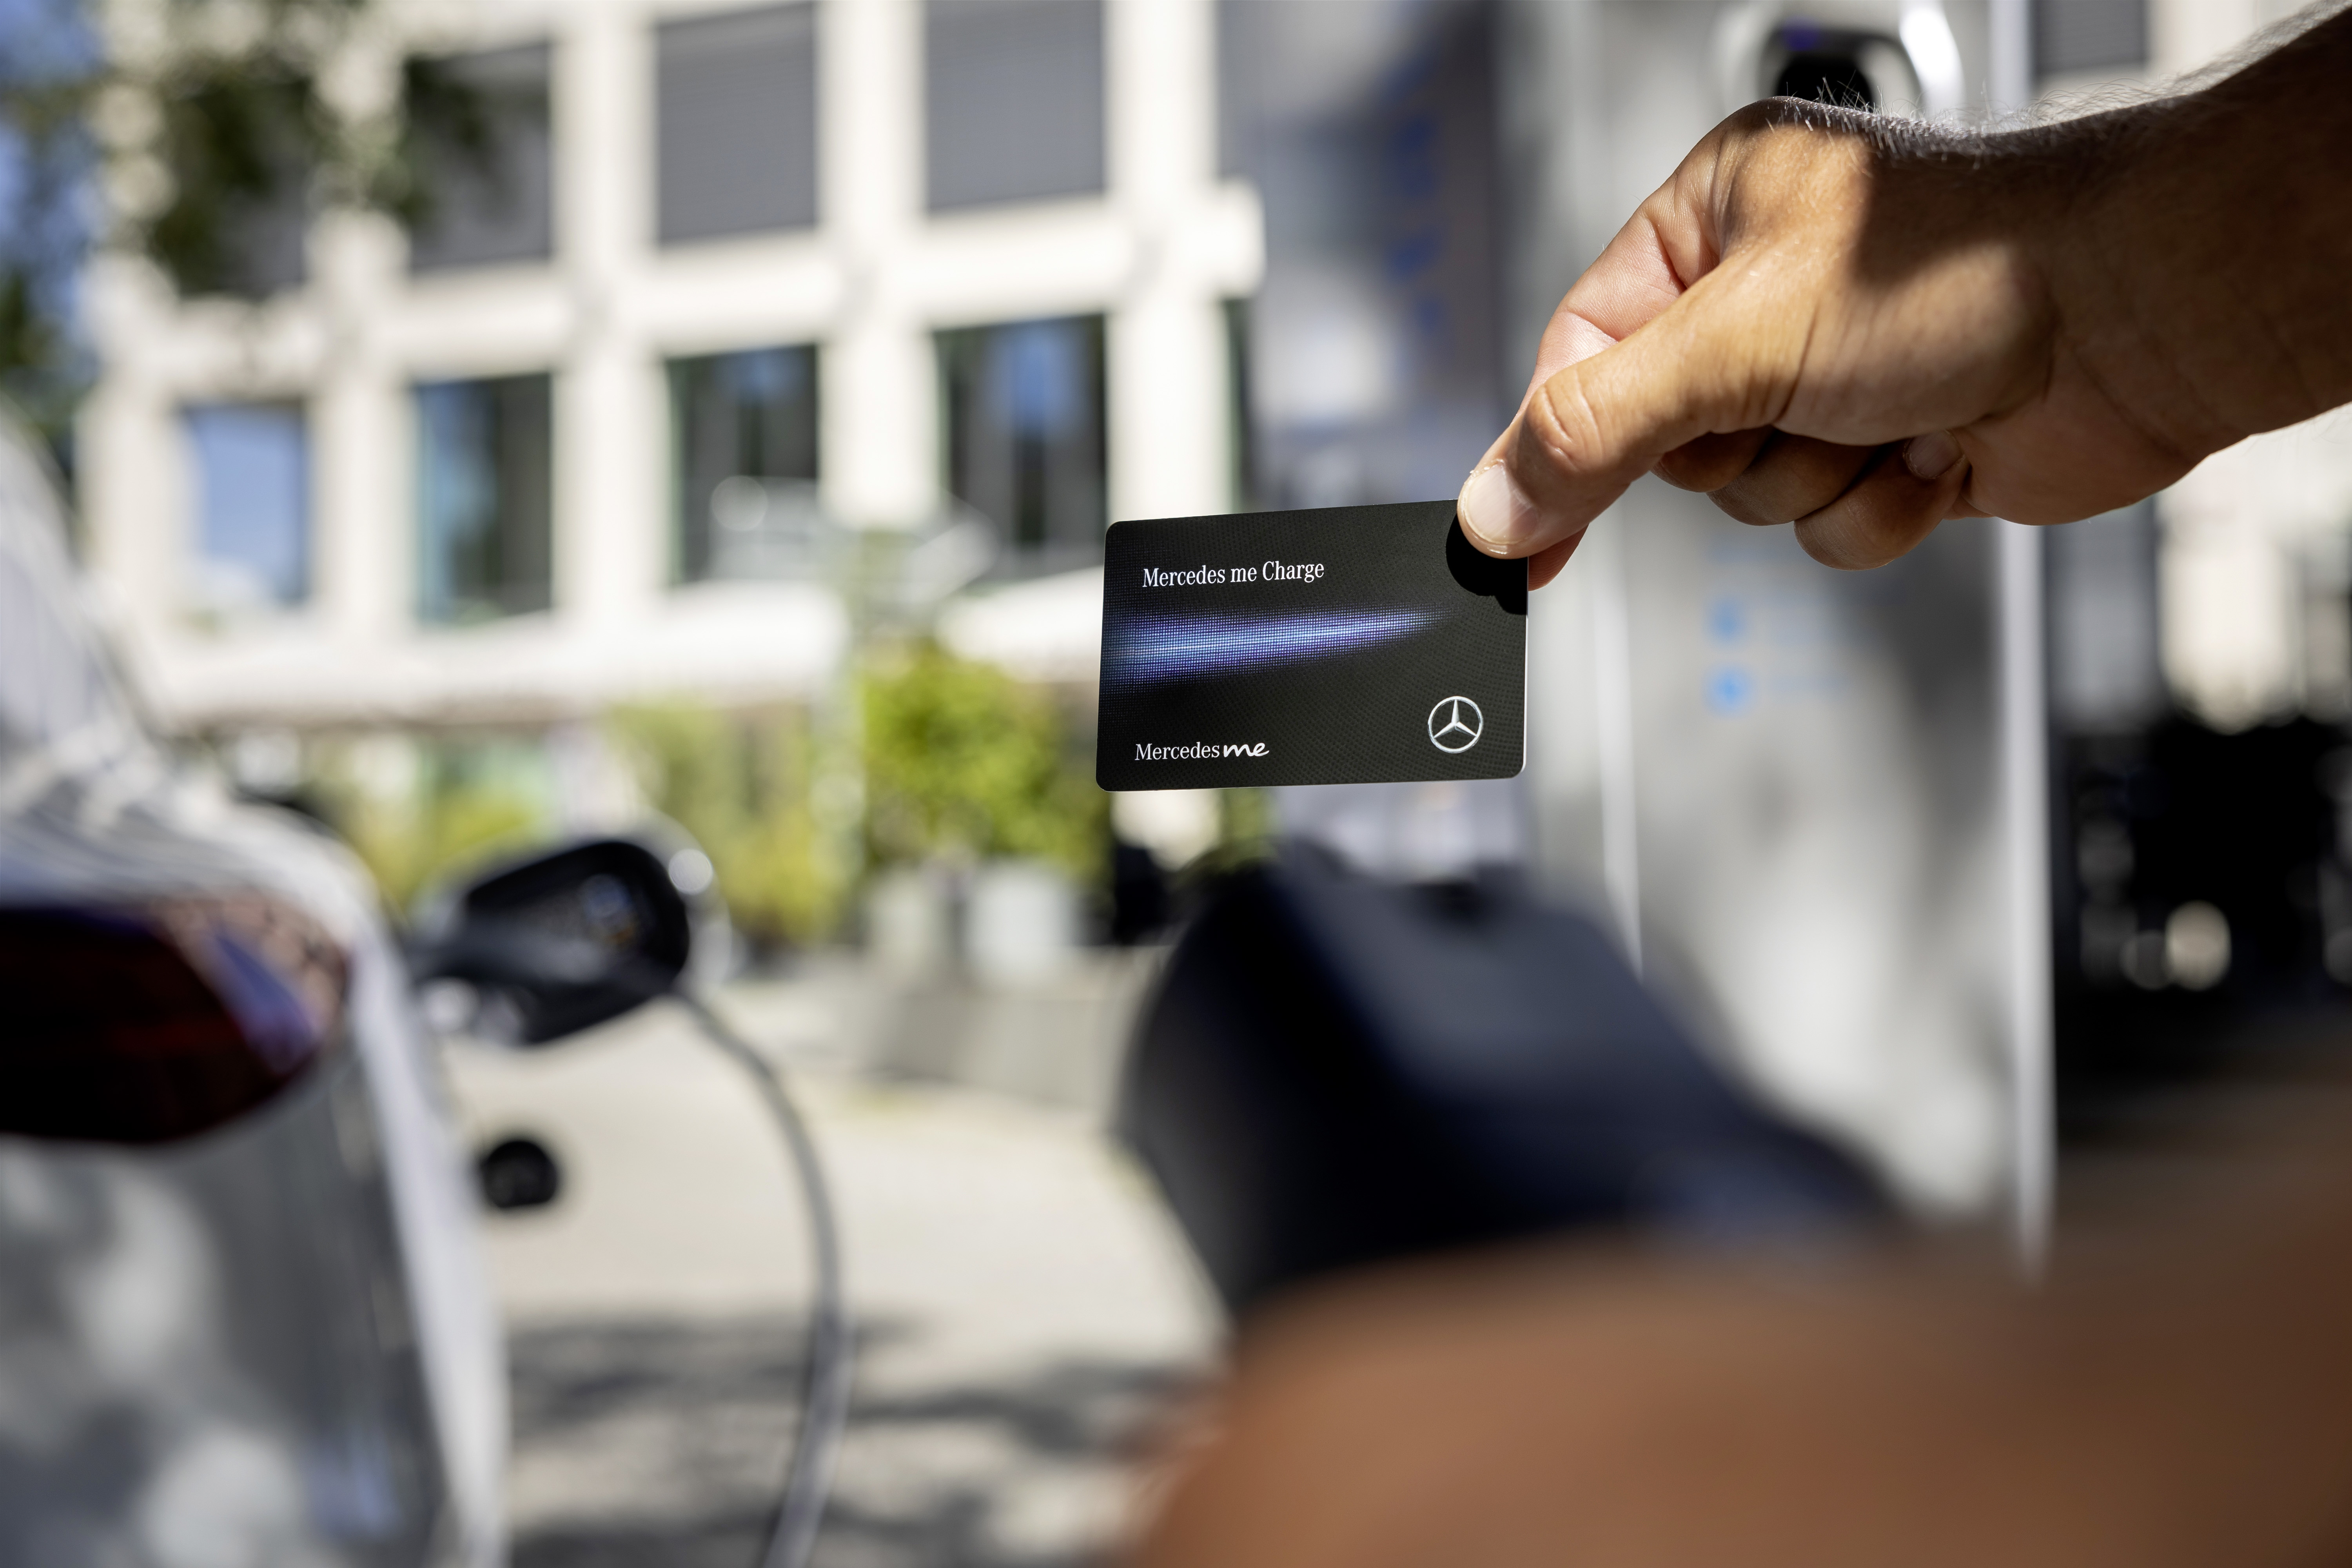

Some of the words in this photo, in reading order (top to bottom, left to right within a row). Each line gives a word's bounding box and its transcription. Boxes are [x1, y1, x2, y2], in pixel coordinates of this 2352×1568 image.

[1142, 564, 1226, 588] Mercedes
[1230, 567, 1258, 583] me
[1262, 561, 1325, 583] Charge
[1134, 741, 1220, 761] Mercedes
[1223, 742, 1270, 758] me
